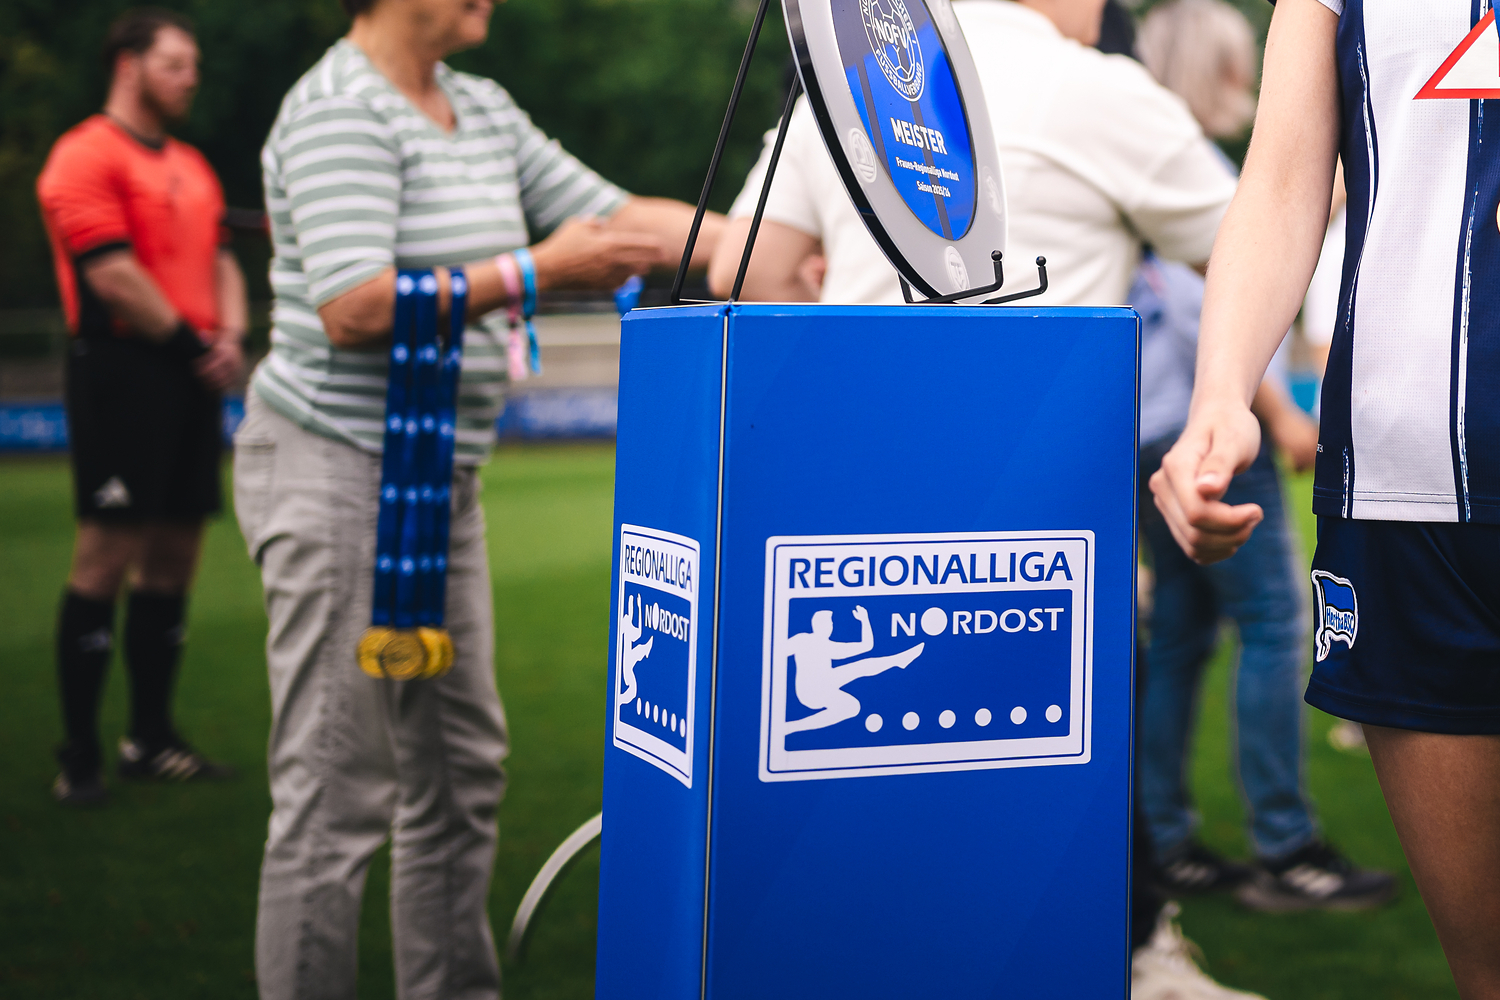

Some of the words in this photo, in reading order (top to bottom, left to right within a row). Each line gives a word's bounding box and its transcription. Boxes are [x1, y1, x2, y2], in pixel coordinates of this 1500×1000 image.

[873, 17, 909, 49] NOFV
[890, 116, 948, 155] MEISTER
[916, 180, 933, 194] Saison
[624, 544, 693, 593] REGIONALLIGA
[788, 550, 1073, 589] REGIONALLIGA
[644, 602, 690, 642] NORDOST
[891, 607, 1064, 637] NORDOST
